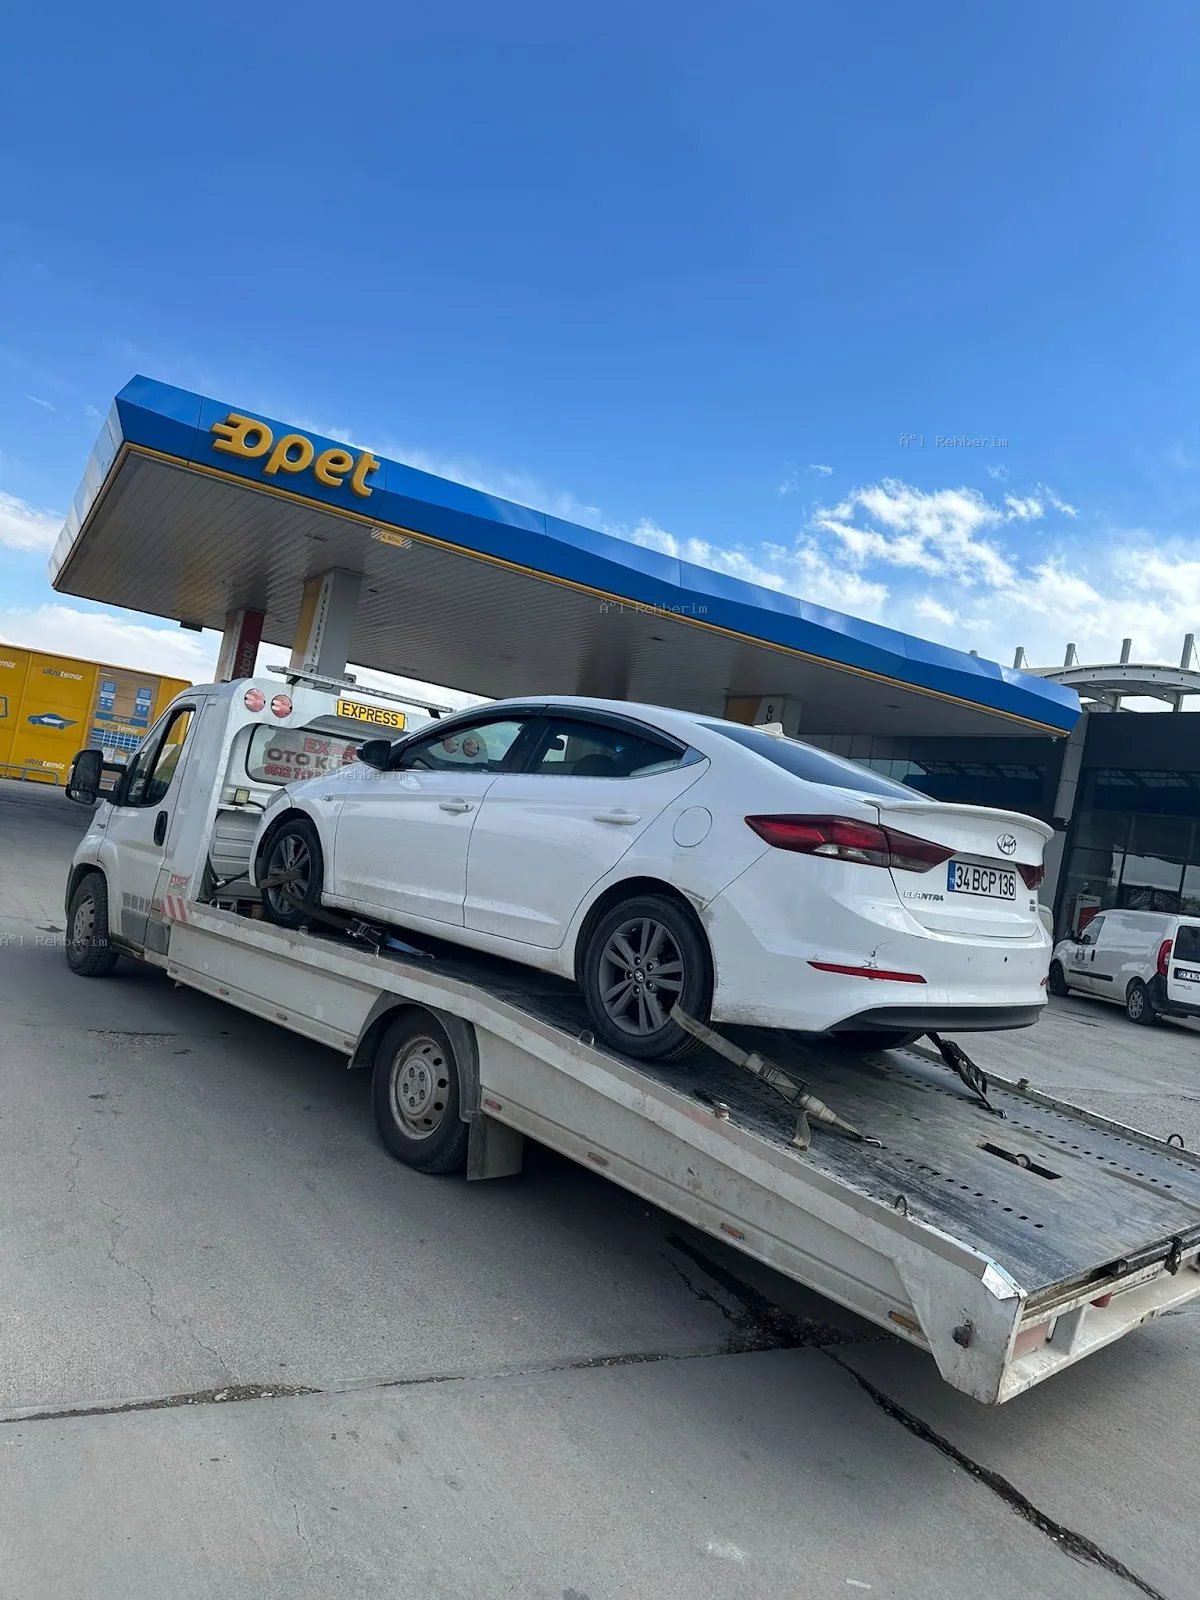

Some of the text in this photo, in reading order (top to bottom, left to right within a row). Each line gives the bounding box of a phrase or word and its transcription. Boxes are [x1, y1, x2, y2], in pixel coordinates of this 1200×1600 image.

[210, 412, 381, 497] opet
[42, 667, 83, 681] ultratemiz
[342, 702, 399, 726] EXPRESS
[24, 757, 65, 770] ultratemiz
[267, 748, 311, 766] OTO
[956, 866, 1015, 896] 34 BCP 136
[903, 890, 944, 902] ELANTRA
